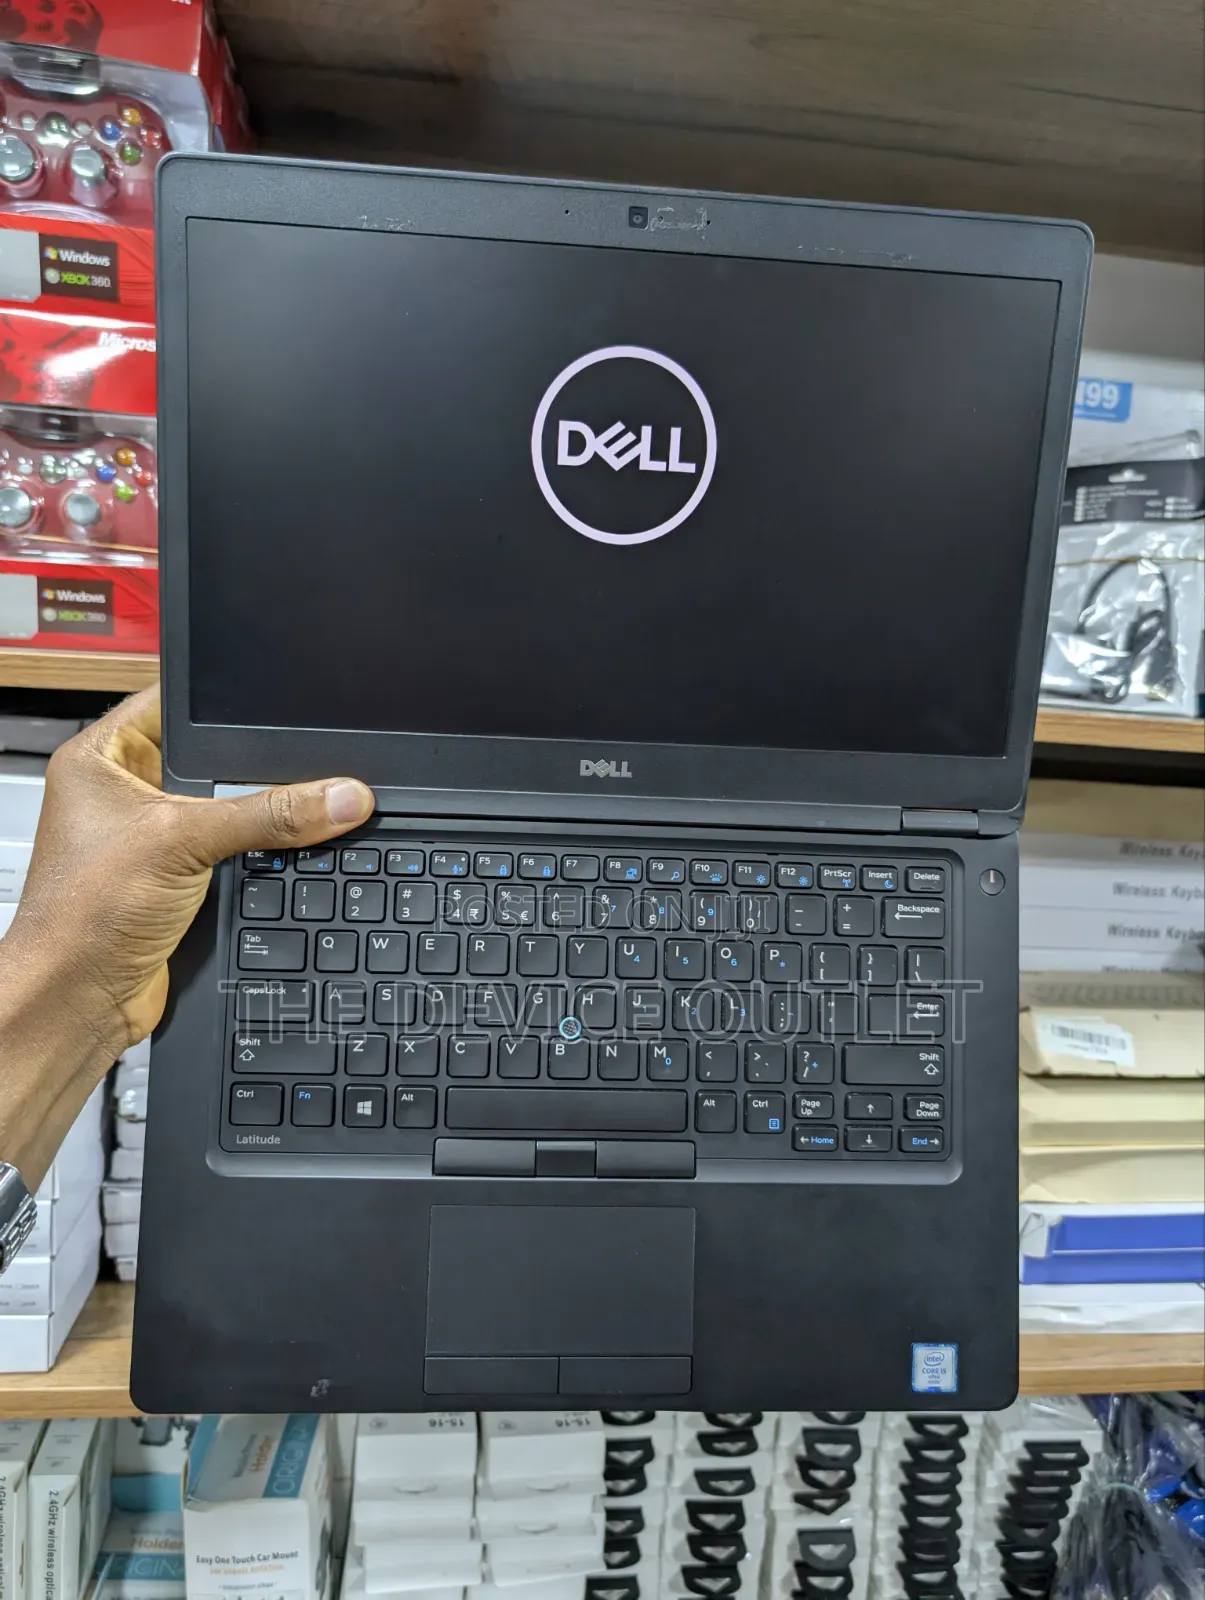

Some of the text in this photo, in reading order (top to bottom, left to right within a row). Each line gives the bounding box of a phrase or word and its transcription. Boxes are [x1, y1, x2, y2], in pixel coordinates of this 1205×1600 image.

[58, 250, 110, 267] Windows
[61, 272, 111, 288] XBOX 360
[557, 420, 696, 473] DELL
[56, 590, 105, 603] Windows
[580, 759, 633, 779] DELL
[299, 851, 310, 859] F1
[1119, 842, 1173, 857] Wireless
[344, 853, 357, 861] F2
[390, 854, 402, 862] F3
[434, 856, 446, 864] F4
[479, 857, 491, 865] F5
[523, 858, 535, 866] F6
[566, 859, 578, 868] F7
[609, 861, 621, 869] F8
[694, 864, 710, 872] F10
[738, 866, 752, 874] F11
[780, 867, 796, 876] F12
[824, 869, 852, 878] PrtScr
[868, 871, 893, 879] Insert
[913, 872, 940, 881] Delete
[349, 886, 363, 899] @
[401, 888, 412, 899] #
[453, 889, 461, 901] $
[1112, 882, 1166, 897] Wireless
[351, 906, 359, 917] 2
[401, 907, 410, 918] 3
[452, 909, 460, 919] 4
[897, 904, 940, 914] Backspace
[502, 910, 510, 920] 5
[551, 911, 560, 921] 6
[600, 913, 609, 923] 7
[649, 914, 657, 925] 8
[697, 916, 706, 926] 9
[1107, 924, 1160, 938] Wireless
[245, 934, 261, 943] Tab
[322, 936, 334, 949] Q
[372, 937, 389, 949] W
[425, 939, 435, 951] E
[475, 940, 485, 952] R
[525, 941, 536, 952] T
[574, 942, 586, 954] Y
[623, 943, 635, 956] U
[720, 947, 732, 959] O
[769, 949, 780, 961] P
[633, 955, 640, 963] 4
[682, 957, 689, 965] 5
[730, 958, 738, 966] 6
[329, 987, 341, 1000] A
[381, 988, 392, 1001] S
[431, 990, 443, 1002] D
[483, 991, 493, 1003] F
[533, 992, 543, 1004] G
[582, 993, 593, 1005] H
[633, 994, 641, 1006] J
[681, 996, 691, 1008] K
[730, 997, 739, 1009] L
[739, 1008, 746, 1016] 3
[917, 1002, 939, 1011] Enter
[239, 1038, 261, 1046] Shift
[352, 1040, 364, 1052] Z
[404, 1041, 415, 1053] X
[454, 1042, 466, 1054] C
[505, 1043, 517, 1055] V
[555, 1044, 565, 1055] B
[606, 1045, 617, 1058] N
[654, 1046, 667, 1058] M
[919, 1053, 940, 1061] Shift
[236, 1089, 254, 1098] Ctrl
[298, 1091, 311, 1099] Fn
[400, 1093, 414, 1101] Alt
[703, 1099, 715, 1107] Alt
[752, 1100, 769, 1108] Ctrl
[801, 1100, 821, 1108] Page
[919, 1102, 939, 1110] Page
[801, 1108, 813, 1116] Up
[916, 1109, 939, 1118] Down
[236, 1134, 281, 1144] Latitude
[811, 1136, 835, 1144] Home
[912, 1137, 928, 1145] End
[47, 1490, 60, 1527] 2.4GHz
[46, 1528, 57, 1570] wireless
[196, 1550, 299, 1565] Easy One Touch Car Mount
